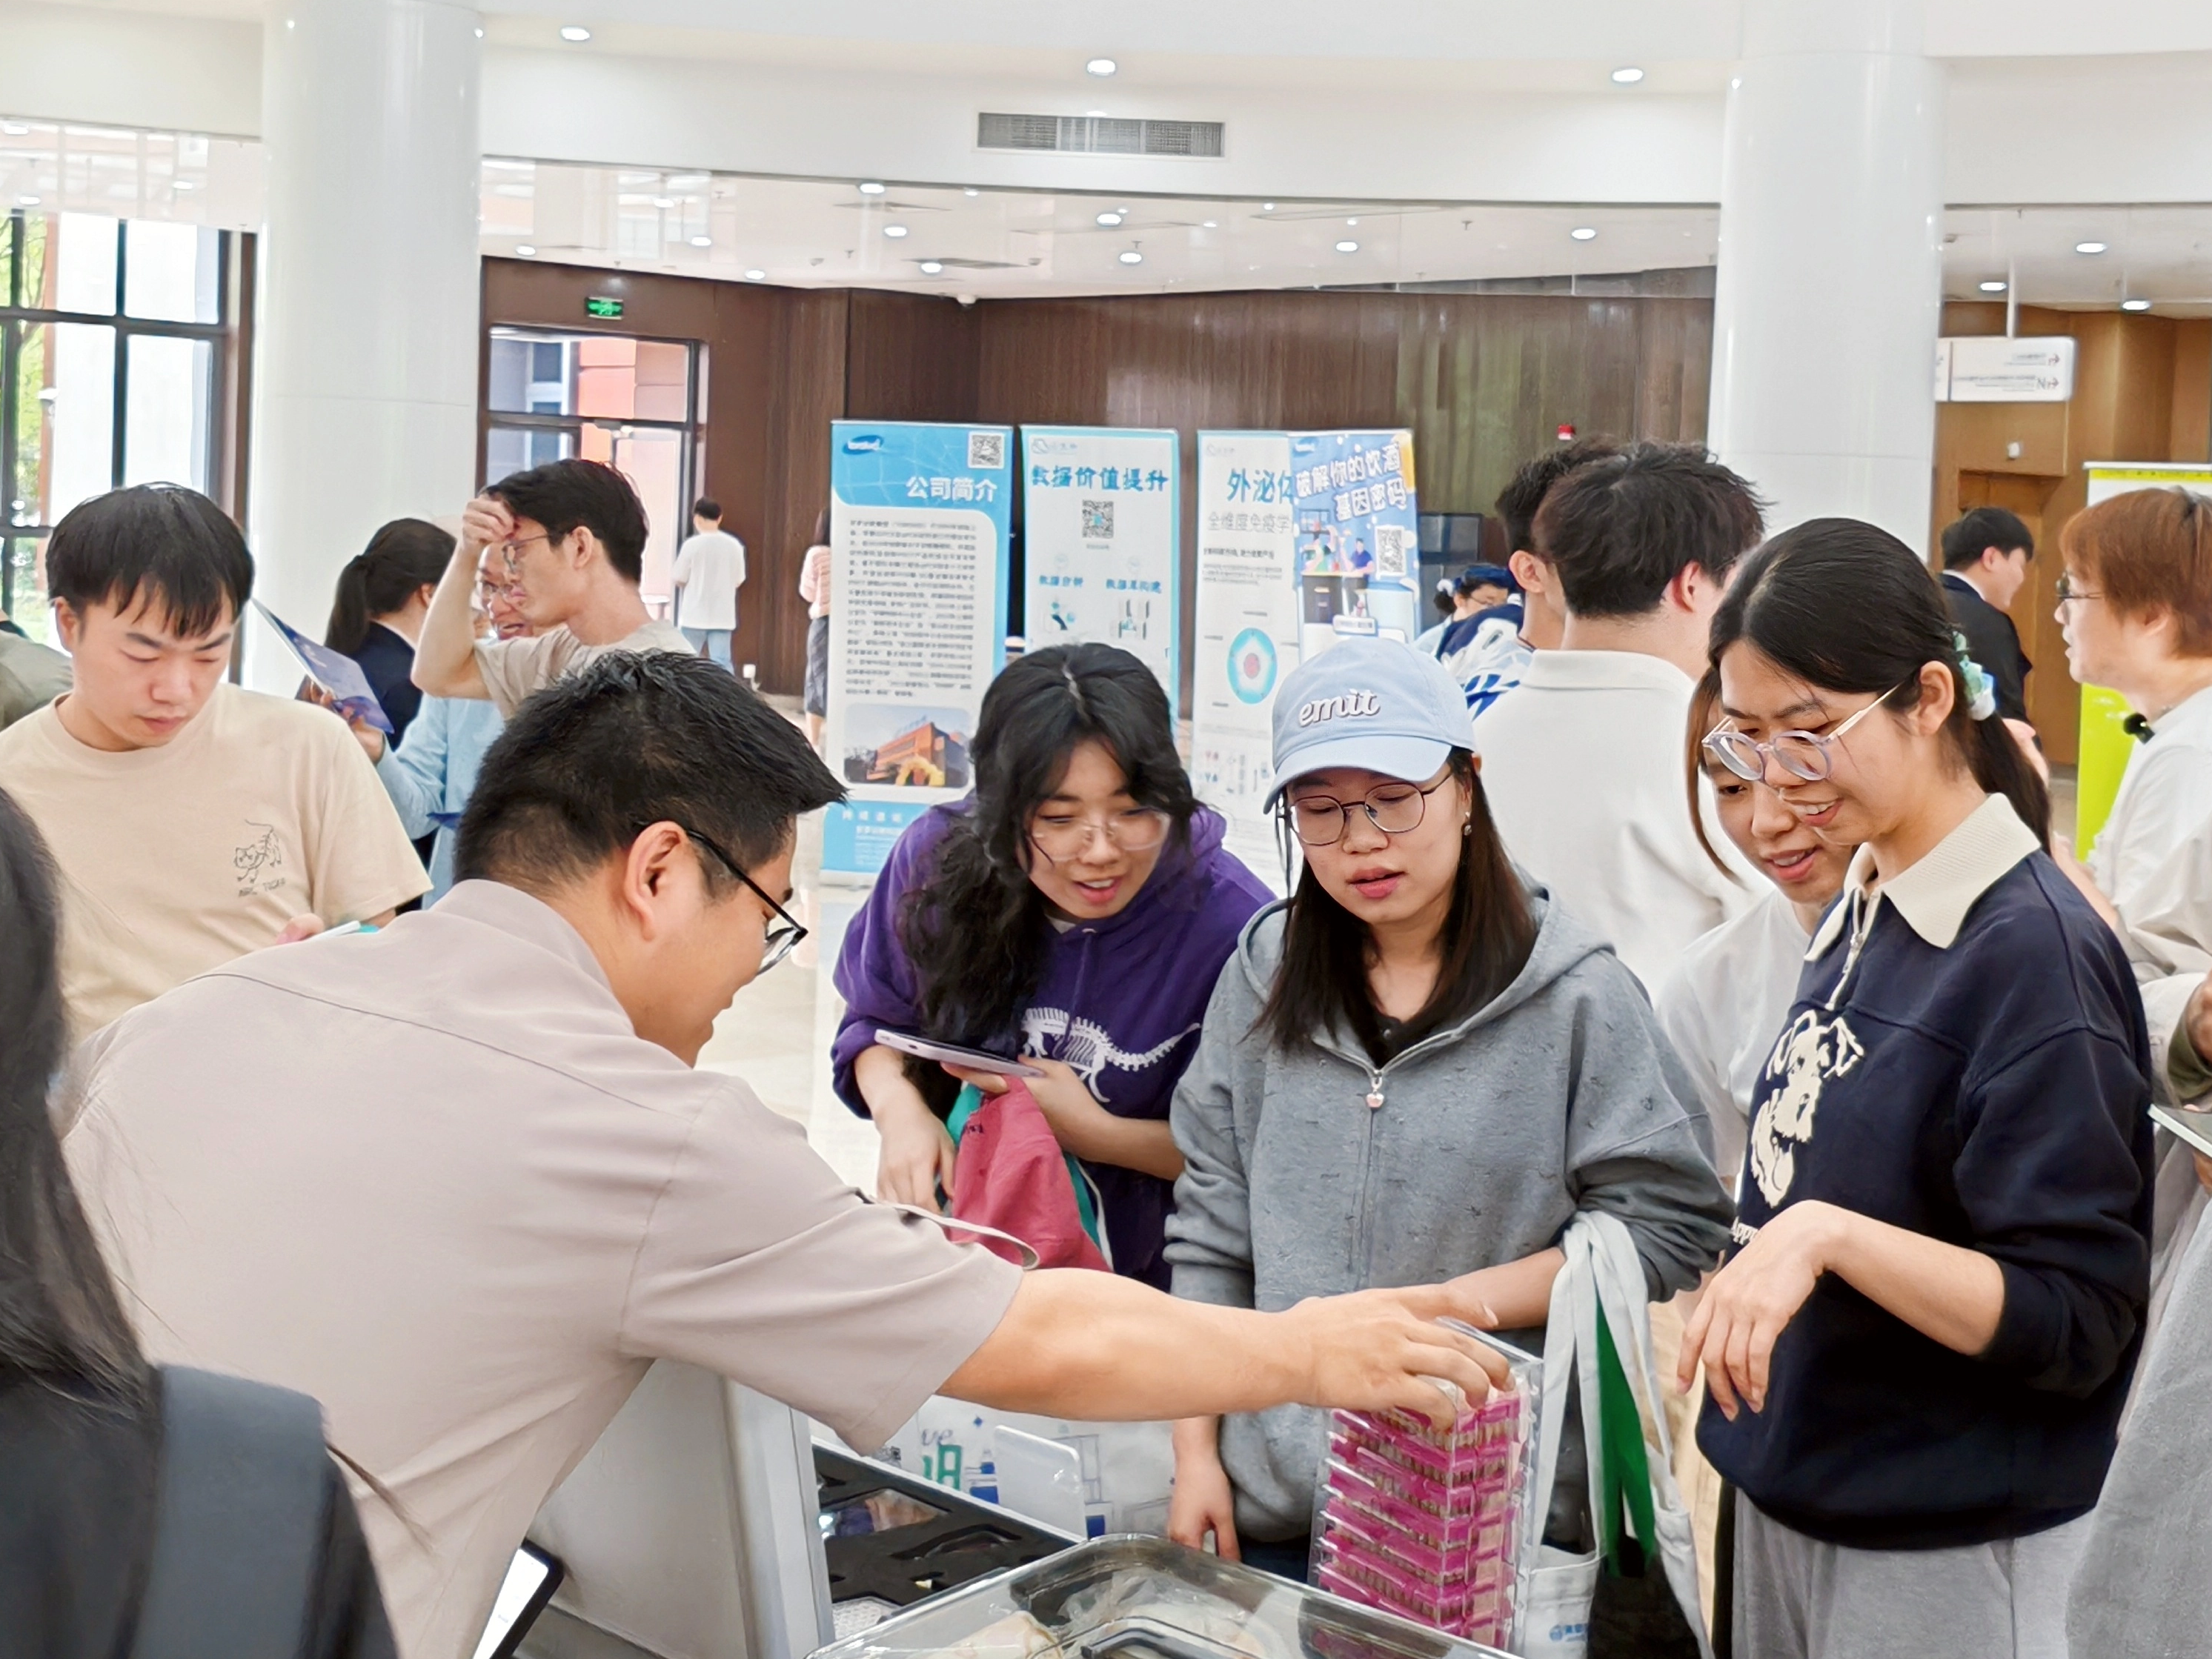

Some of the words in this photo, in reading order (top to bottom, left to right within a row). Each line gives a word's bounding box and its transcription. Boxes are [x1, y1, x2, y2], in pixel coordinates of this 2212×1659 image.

[906, 476, 997, 502] 公司简介
[1032, 465, 1169, 492] 数据价值提升
[1334, 477, 1407, 522] 基因密码
[1298, 688, 1381, 727] emit
